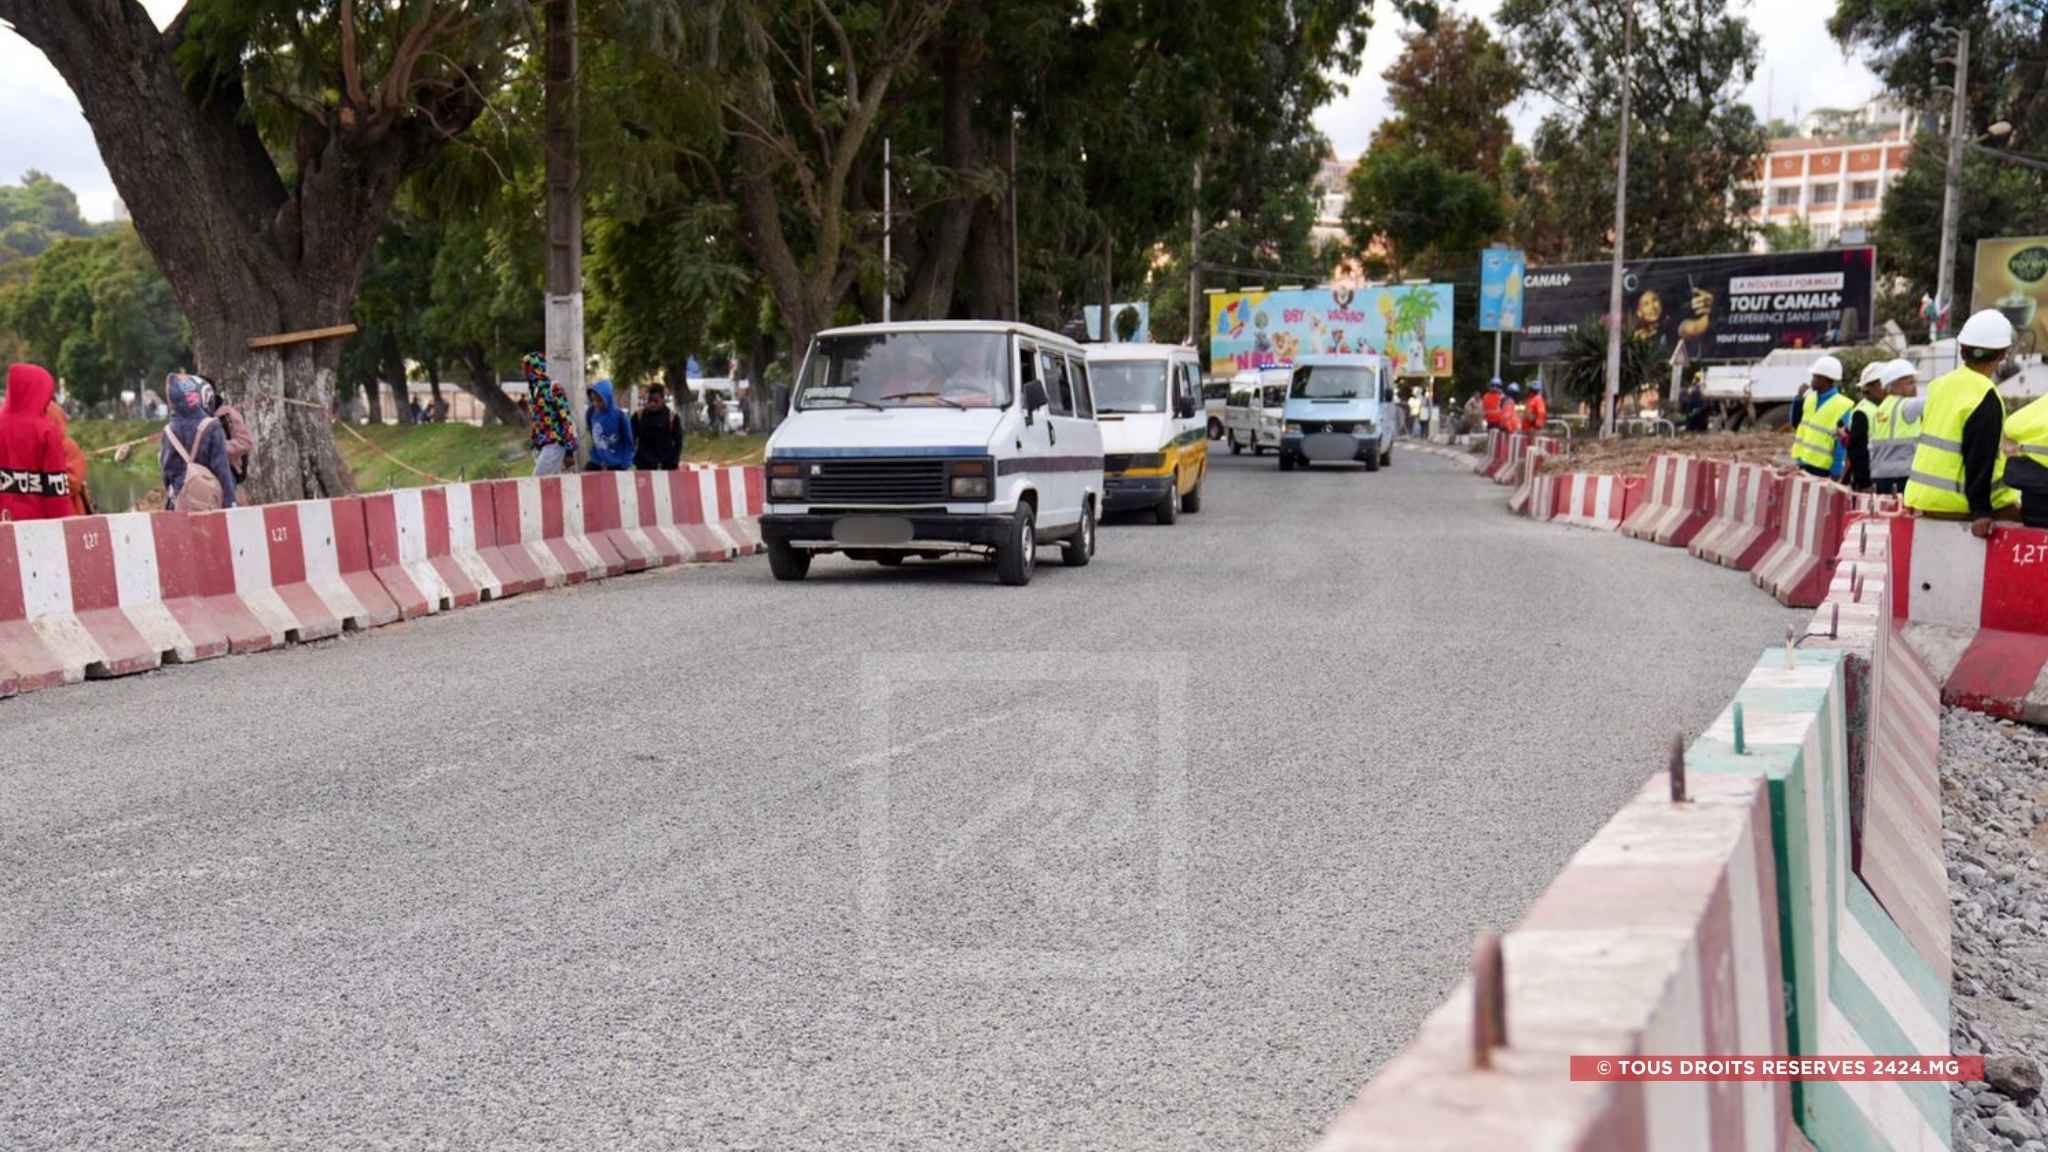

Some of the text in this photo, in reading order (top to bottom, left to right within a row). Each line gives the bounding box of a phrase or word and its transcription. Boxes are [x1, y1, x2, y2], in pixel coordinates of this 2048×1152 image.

[1524, 274, 1571, 287] CANAL+
[1729, 292, 1841, 311] TOUT CANAL+
[1716, 333, 1771, 343] TOUT CANAL+
[2012, 544, 2048, 567] 1,2T
